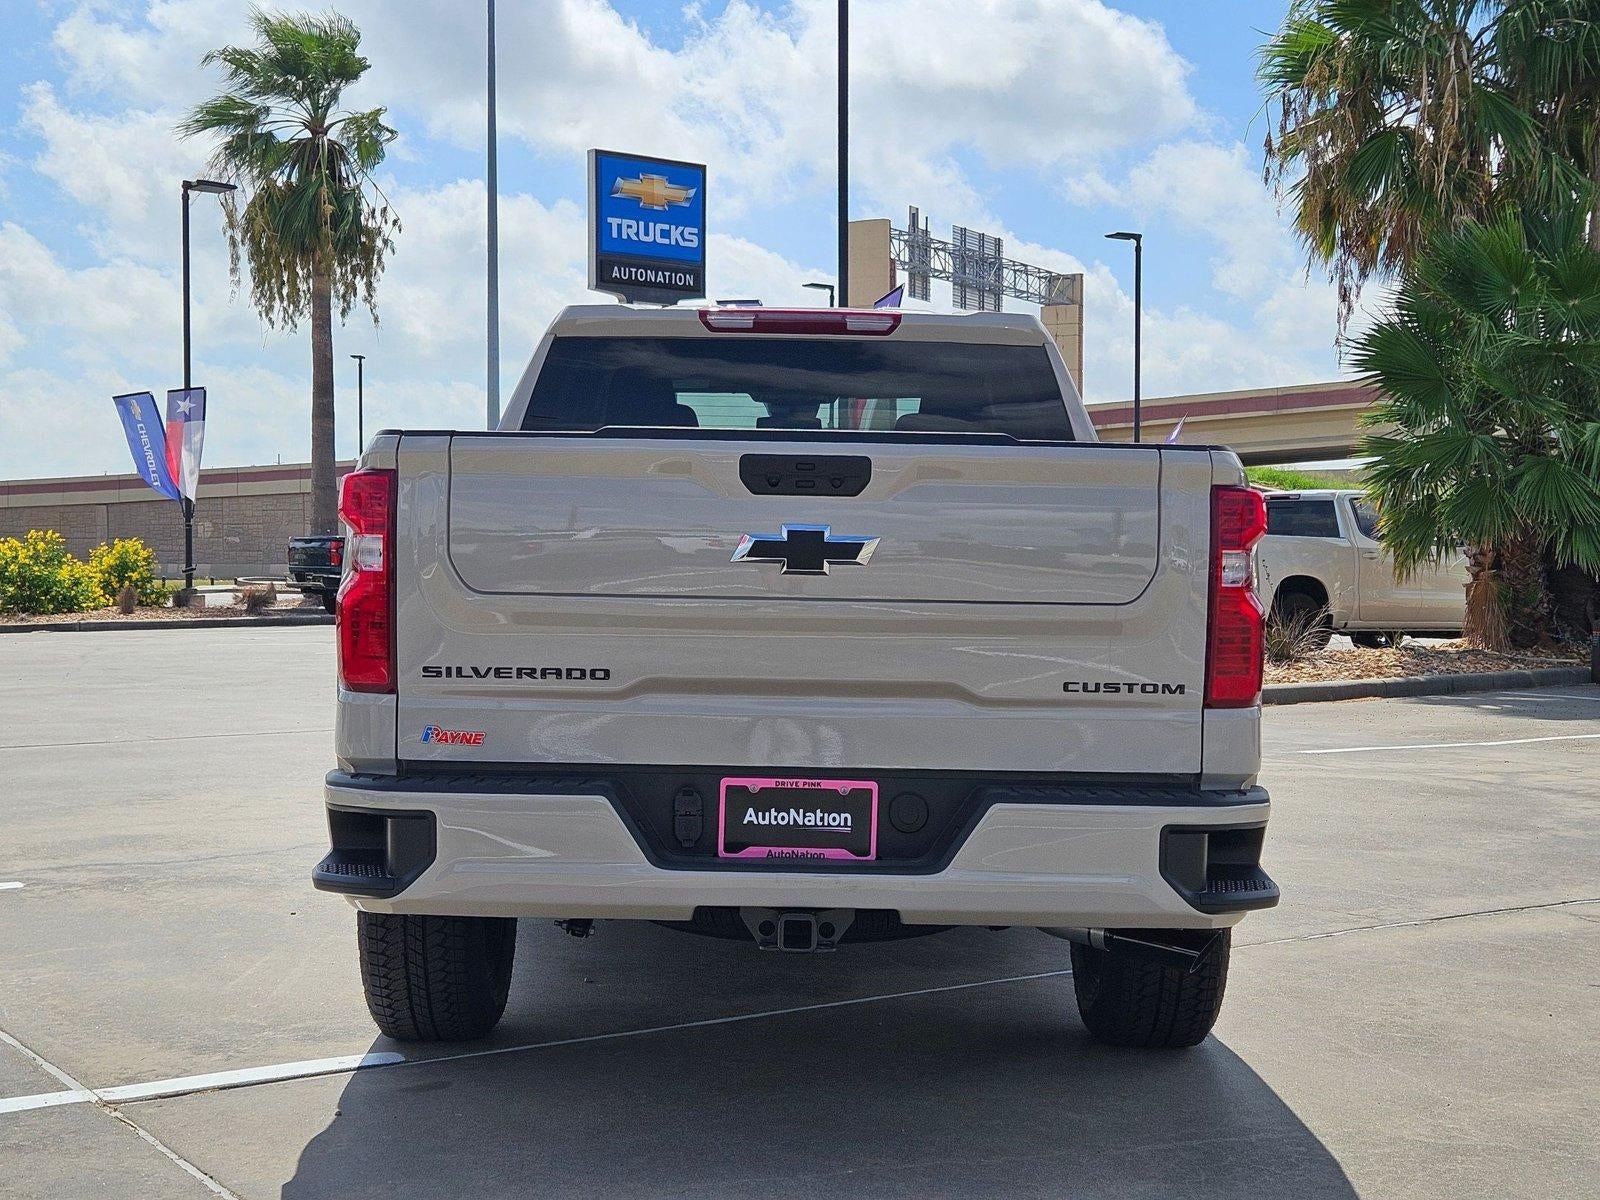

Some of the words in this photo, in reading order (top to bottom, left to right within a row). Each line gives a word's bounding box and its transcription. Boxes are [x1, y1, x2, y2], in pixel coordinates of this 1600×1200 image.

[607, 217, 699, 248] TRUCKS
[612, 266, 694, 287] AUTONATION
[137, 423, 161, 488] CHEVROLET
[421, 665, 611, 681] SILVERADO
[1062, 681, 1186, 695] CUSTOM
[421, 725, 485, 747] PAYNE
[775, 780, 800, 788] DRIVE
[742, 807, 852, 827] AutoNation
[767, 849, 826, 860] AutoNation
